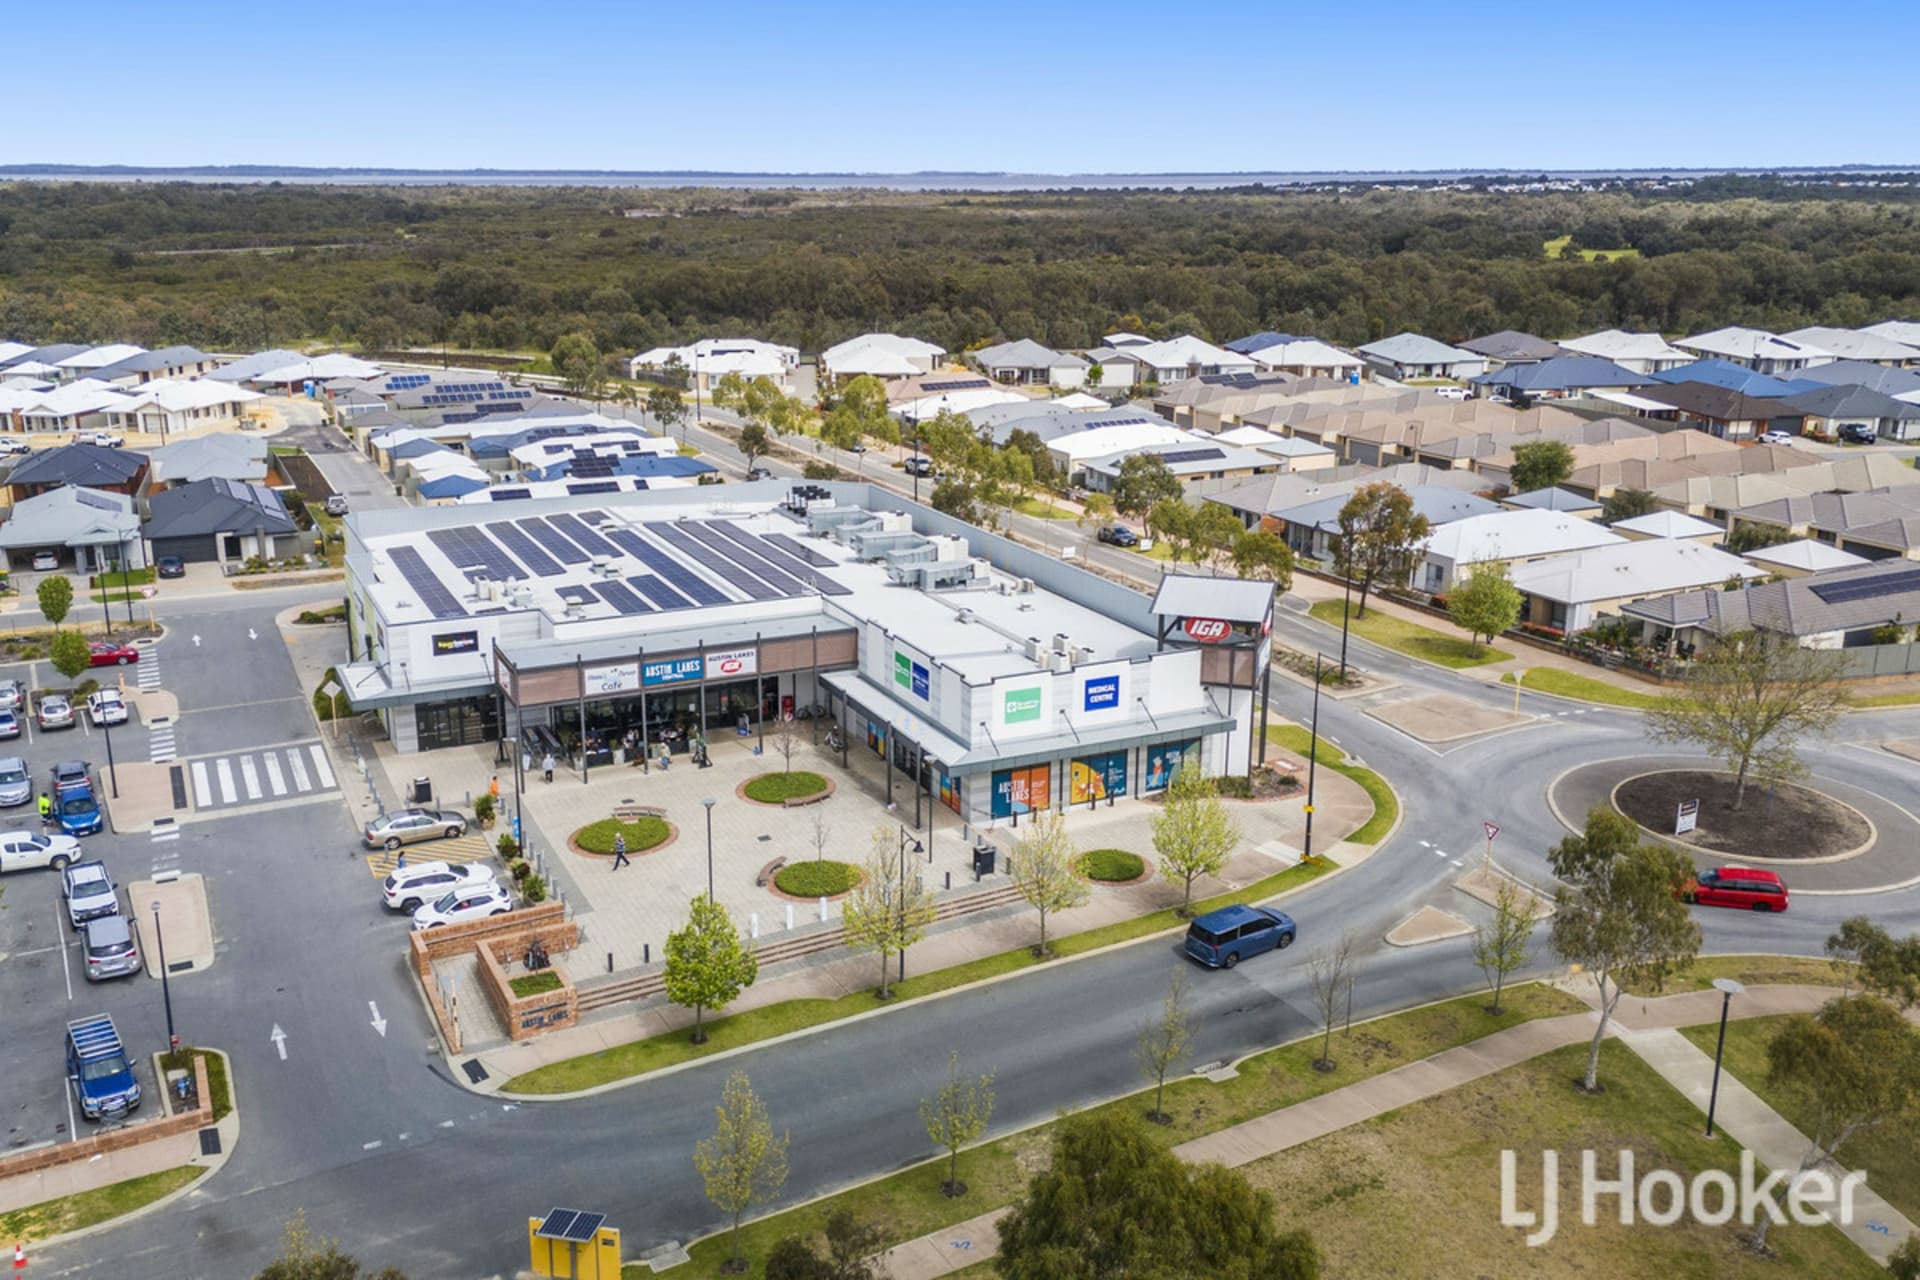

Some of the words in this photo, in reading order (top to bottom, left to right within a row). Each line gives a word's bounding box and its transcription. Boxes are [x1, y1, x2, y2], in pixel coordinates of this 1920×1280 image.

[1190, 620, 1225, 636] IGA
[708, 654, 732, 662] AUSTIN
[645, 664, 672, 677] AUSTIN
[676, 660, 700, 673] LAKES
[1088, 683, 1115, 694] MEDICAL
[1090, 693, 1113, 703] CENTRE
[998, 780, 1025, 793] AUSTIN
[1006, 788, 1030, 803] LAKES
